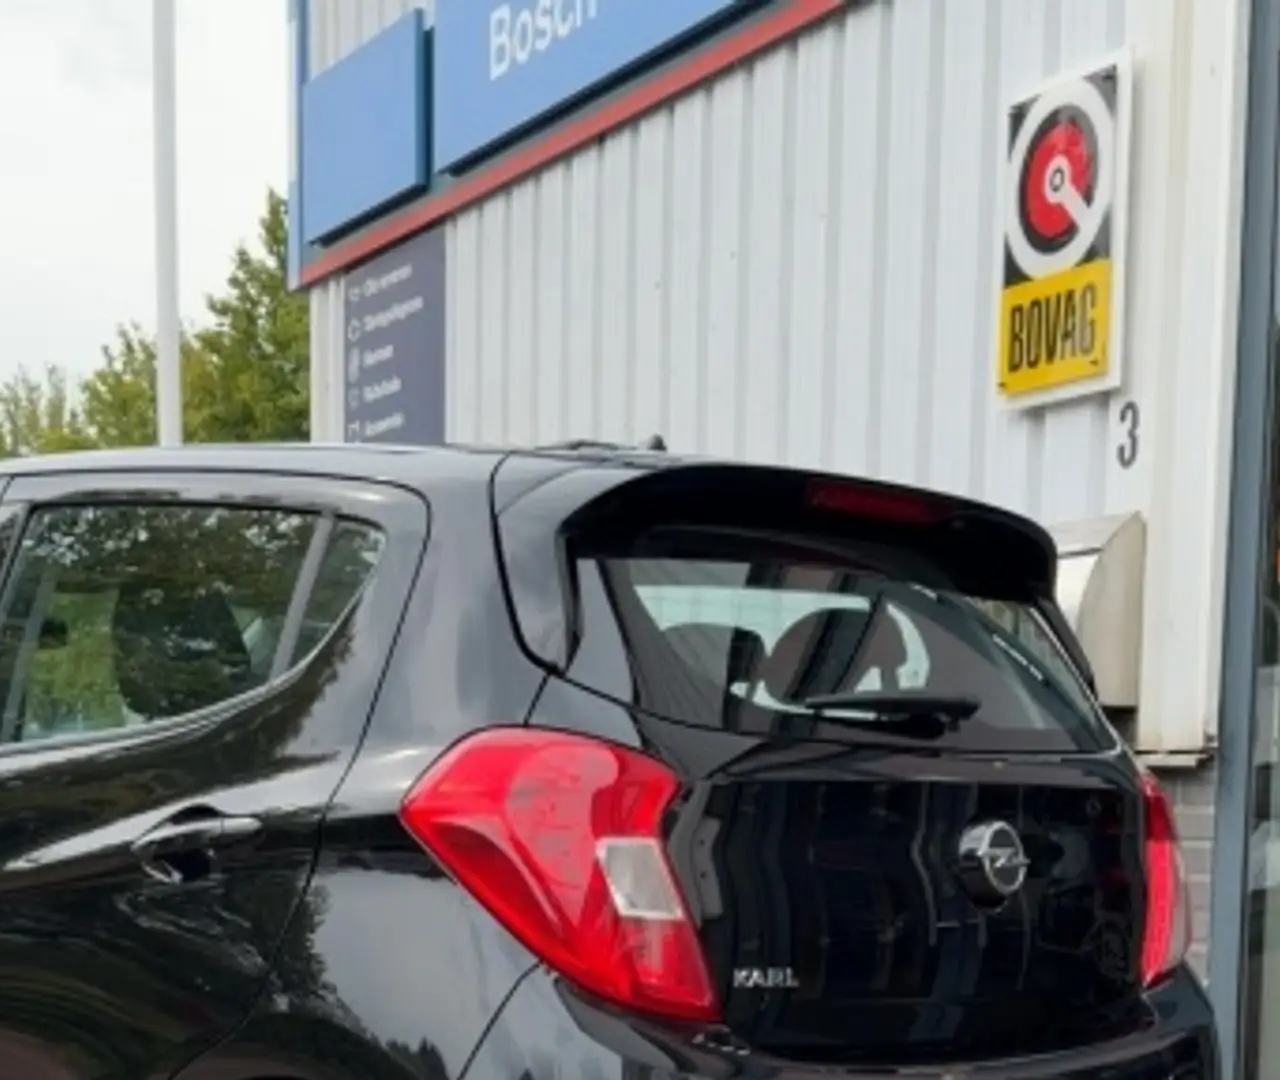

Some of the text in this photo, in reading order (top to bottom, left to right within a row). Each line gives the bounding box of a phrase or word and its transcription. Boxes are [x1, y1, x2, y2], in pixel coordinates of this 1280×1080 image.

[1007, 281, 1097, 374] BOVAG
[1116, 400, 1140, 469] 3
[733, 967, 799, 988] KARL
